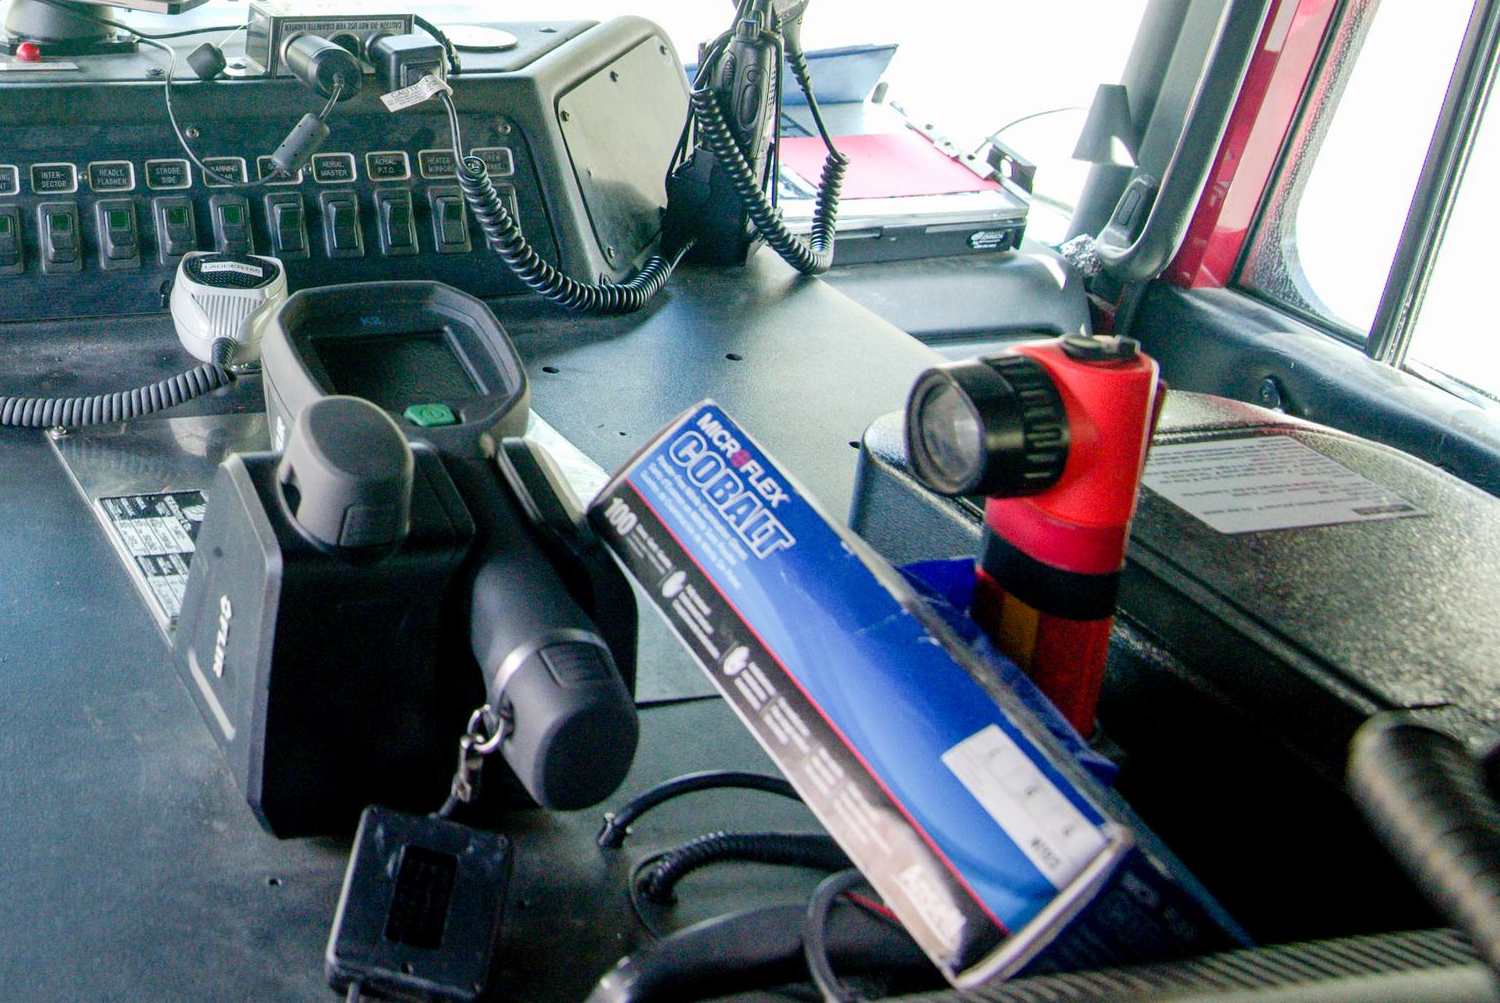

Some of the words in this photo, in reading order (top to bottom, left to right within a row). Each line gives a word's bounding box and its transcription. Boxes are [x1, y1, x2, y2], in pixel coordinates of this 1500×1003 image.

[41, 180, 67, 188] SECTOR
[156, 167, 180, 175] STROBE
[696, 412, 790, 508] MICROFLEX
[669, 430, 796, 560] COBALT
[604, 497, 638, 537] 100
